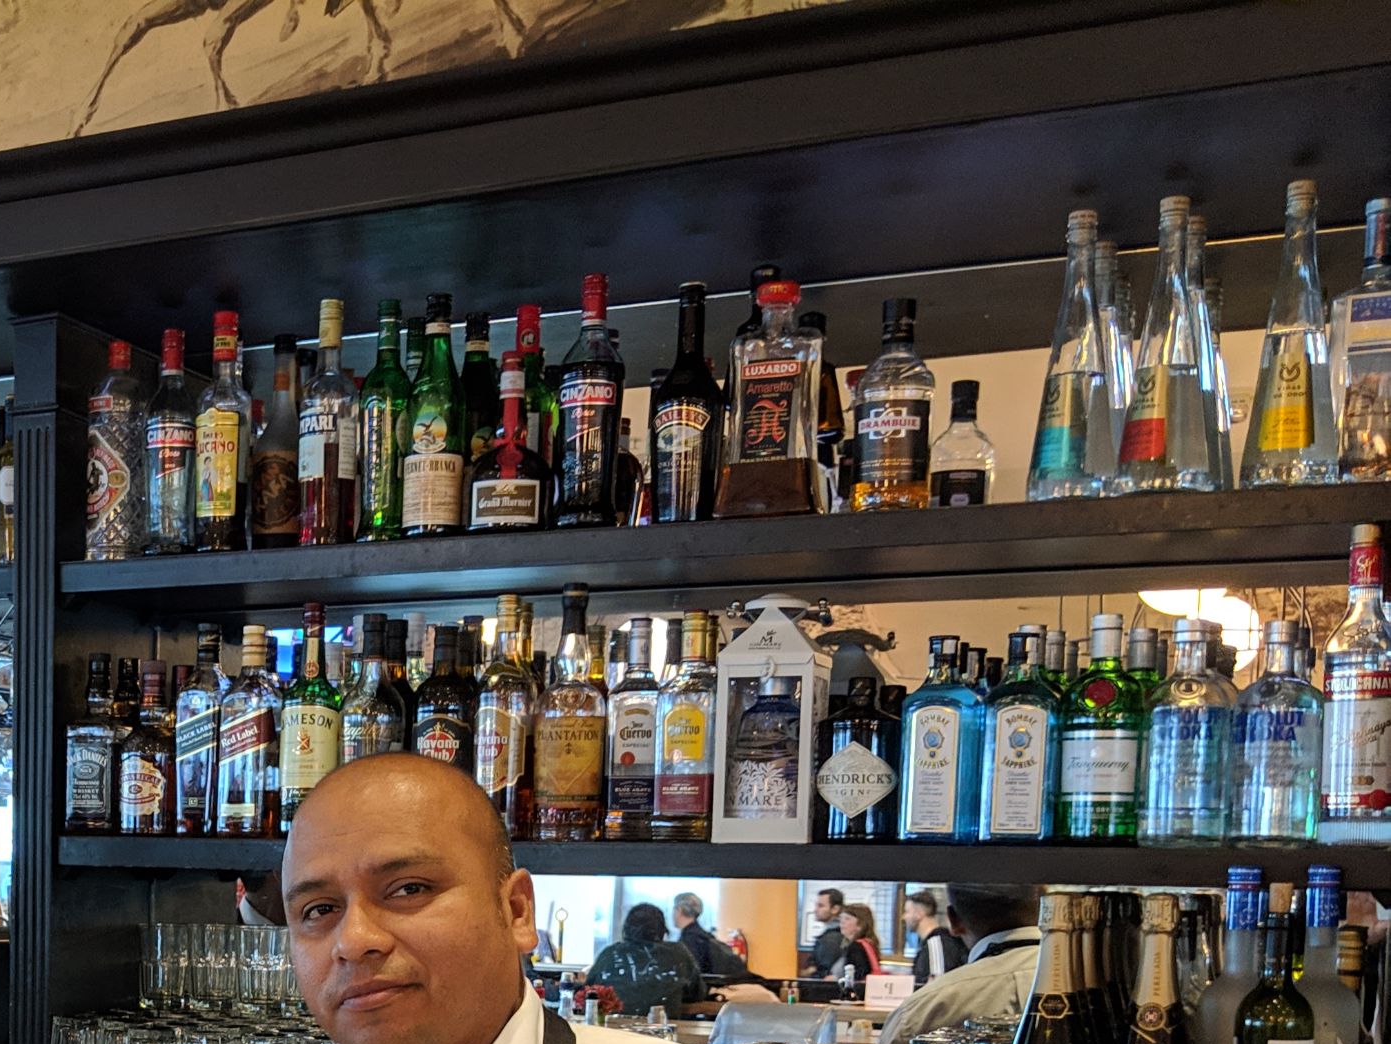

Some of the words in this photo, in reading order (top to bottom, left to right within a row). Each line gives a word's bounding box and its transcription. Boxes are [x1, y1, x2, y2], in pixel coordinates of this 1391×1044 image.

[744, 363, 797, 376] LUXARDO
[560, 384, 613, 402] CINZANO
[746, 381, 794, 395] Amaretto
[655, 409, 704, 428] BAILEYS
[860, 419, 918, 431] DRAMBUIE
[147, 428, 194, 442] CINZANO
[281, 712, 333, 730] JAMESON
[1006, 714, 1037, 725] BOMBAY
[221, 735, 236, 748] Red
[237, 726, 258, 742] Label
[537, 729, 600, 741] PLANTATION
[620, 726, 652, 741] Cuervo
[417, 737, 459, 750] Havana
[819, 773, 893, 785] HENDRICK'S
